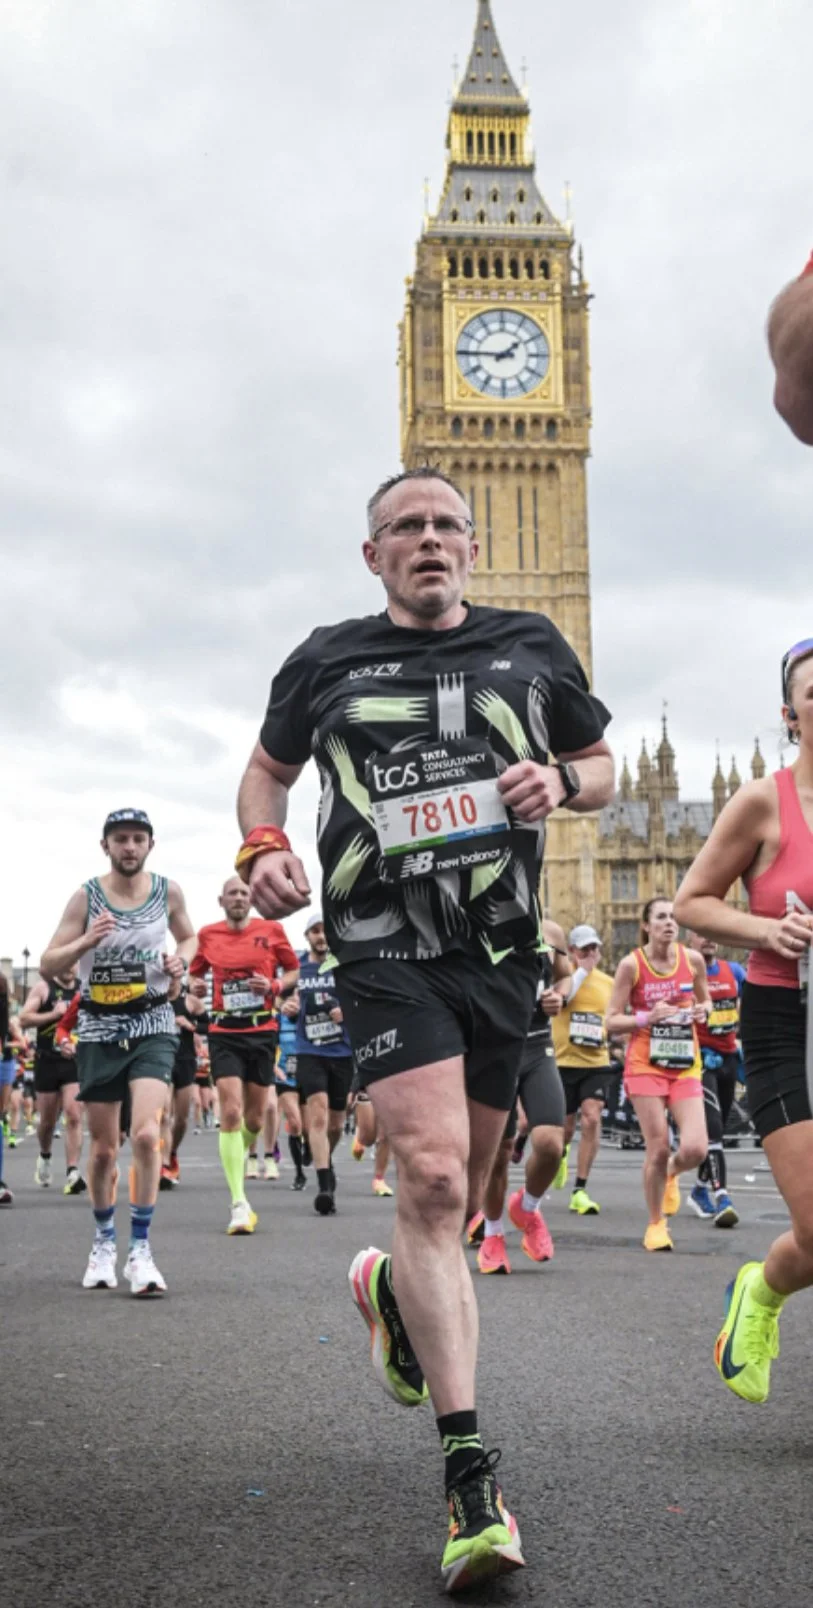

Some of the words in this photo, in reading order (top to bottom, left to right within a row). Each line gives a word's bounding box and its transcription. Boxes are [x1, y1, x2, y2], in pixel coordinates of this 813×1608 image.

[420, 749, 448, 762] TATA
[422, 753, 486, 772] CONSULTANCY
[373, 761, 420, 792] tcs
[425, 767, 466, 782] SERVICES
[402, 793, 477, 837] 7810
[400, 851, 434, 879] NB
[436, 858, 459, 871] new
